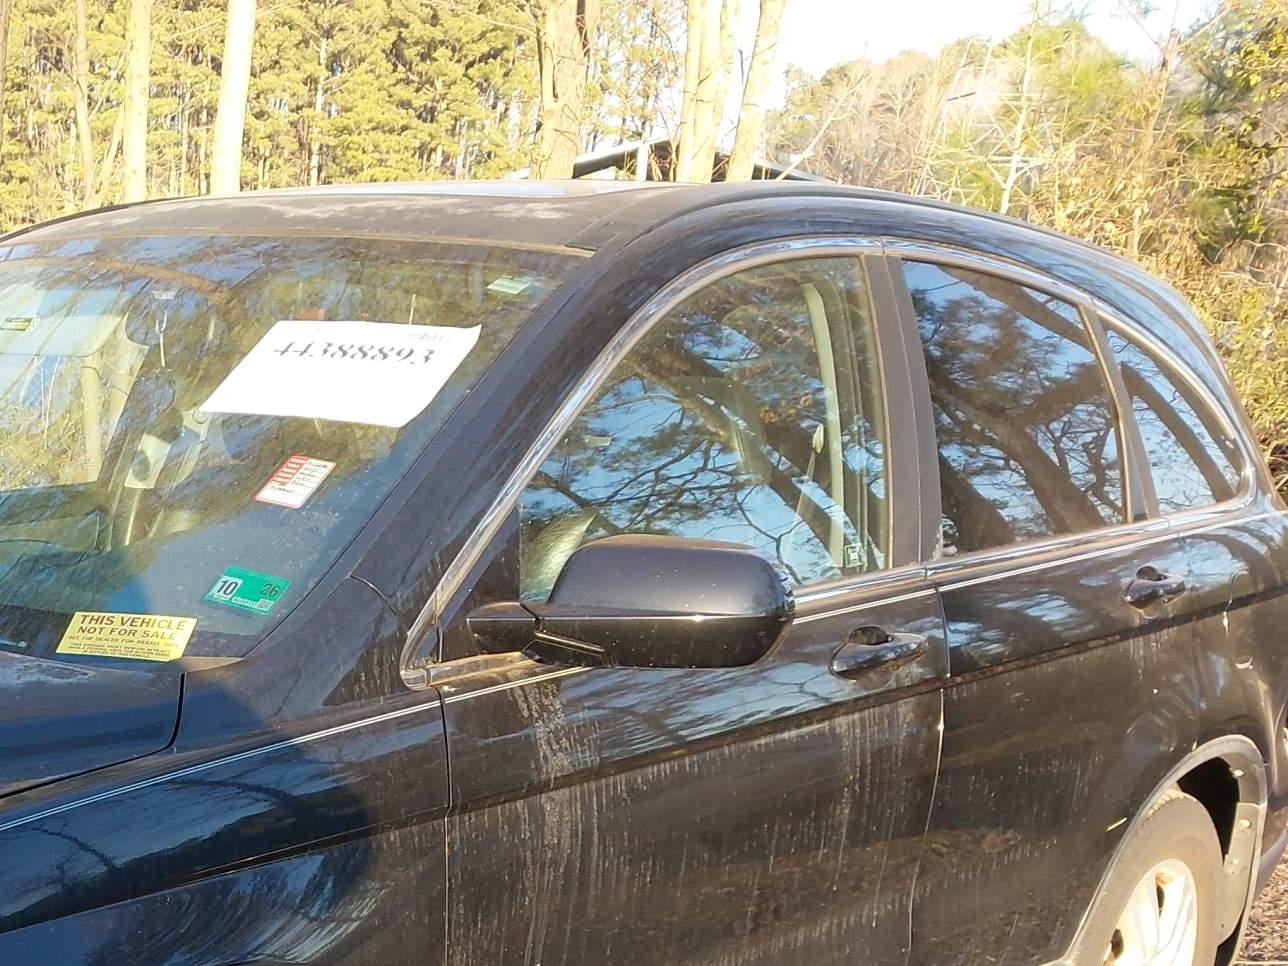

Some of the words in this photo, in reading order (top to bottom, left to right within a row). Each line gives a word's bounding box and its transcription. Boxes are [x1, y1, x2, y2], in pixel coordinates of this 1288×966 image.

[273, 341, 436, 365] 44388893
[217, 580, 239, 596] 10
[260, 583, 281, 597] 26
[80, 615, 115, 626] THIS
[120, 616, 188, 631] VEHICLE
[77, 626, 107, 636] NOT
[109, 627, 138, 638] FOR
[141, 630, 178, 640] SALE
